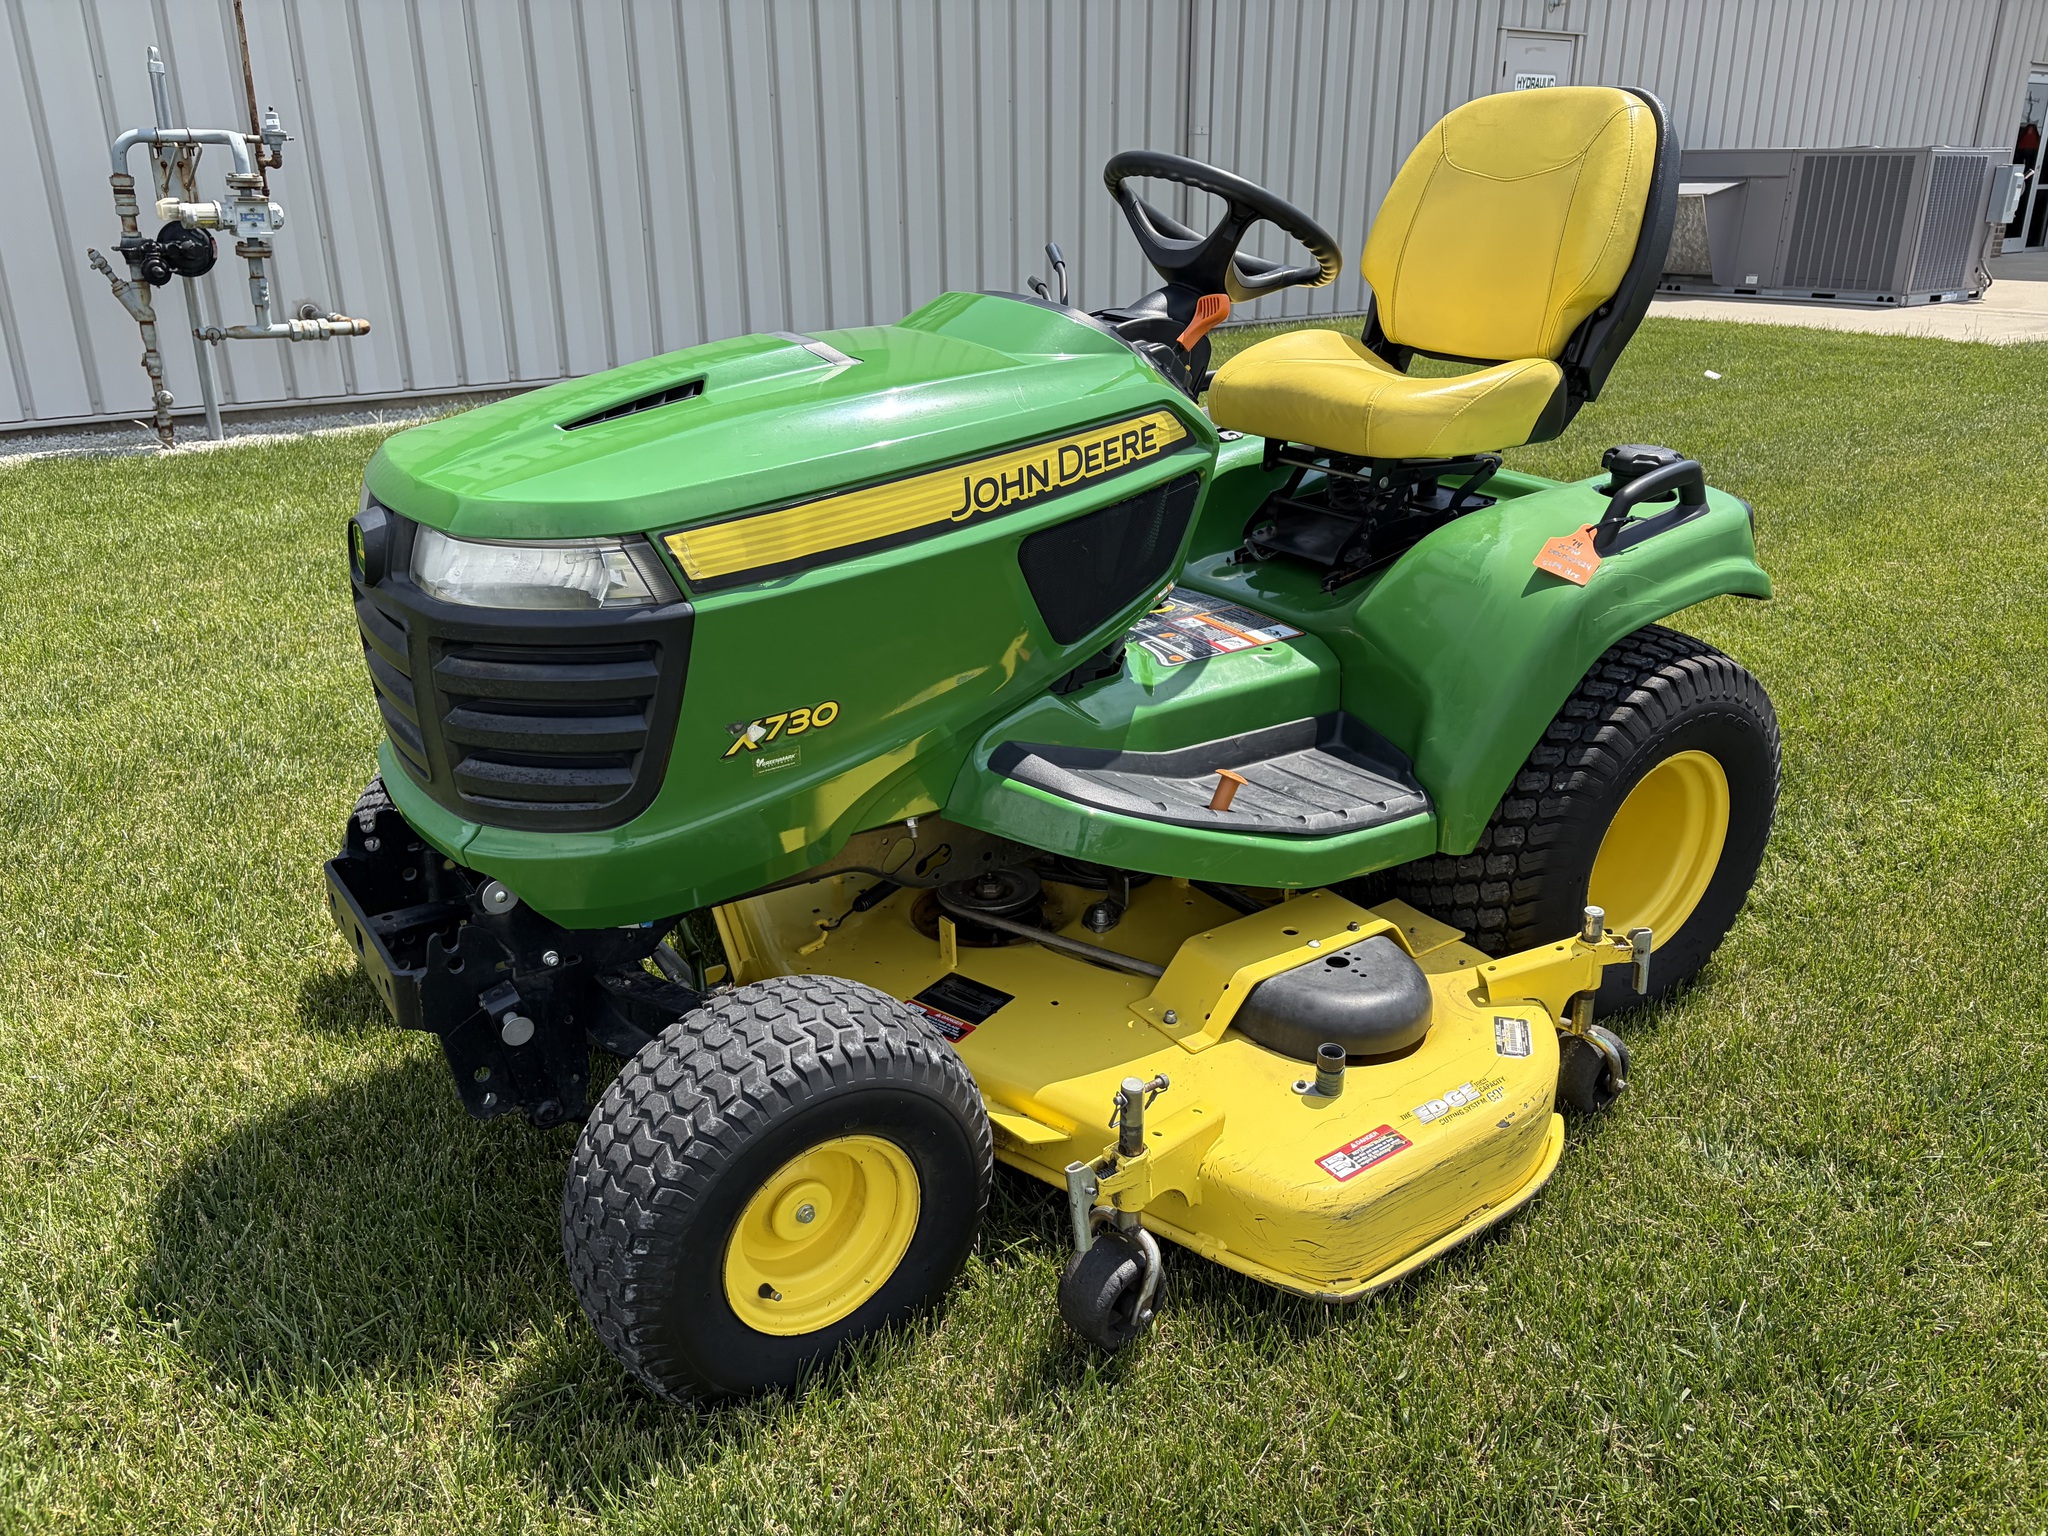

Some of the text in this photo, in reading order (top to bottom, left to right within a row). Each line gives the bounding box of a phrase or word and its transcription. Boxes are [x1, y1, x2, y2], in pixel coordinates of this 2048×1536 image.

[1516, 76, 1555, 89] HYDRAULIC
[951, 421, 1159, 520] JOHN DEERE
[941, 1014, 964, 1027] DANGER
[1400, 1076, 1506, 1126] THE EDGE CAPACITY
[1438, 1110, 1465, 1126] CUTTING
[1464, 1097, 1487, 1114] SYSTEM
[1356, 1130, 1379, 1145] DANGER
